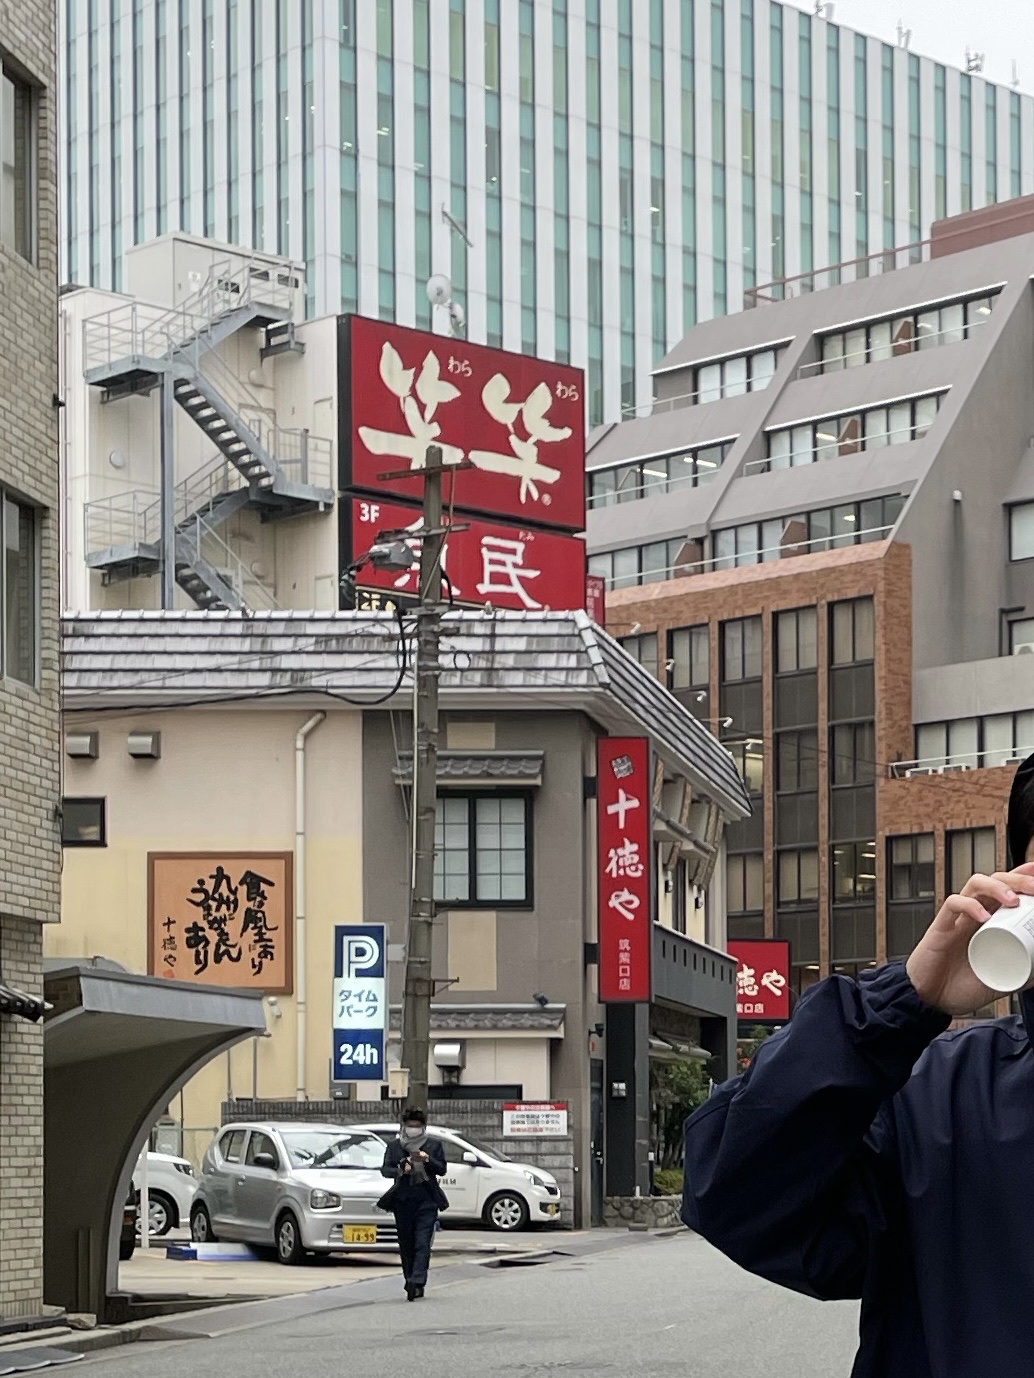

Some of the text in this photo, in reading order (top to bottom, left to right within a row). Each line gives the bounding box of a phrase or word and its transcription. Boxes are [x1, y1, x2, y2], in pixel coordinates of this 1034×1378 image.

[447, 356, 473, 378] わら
[555, 381, 580, 402] わら
[359, 502, 381, 523] 3F
[605, 787, 645, 921] 十徳や
[342, 934, 380, 978] P
[339, 989, 379, 1003] タイム
[338, 1004, 378, 1018] パーク
[339, 1043, 379, 1065] 24h
